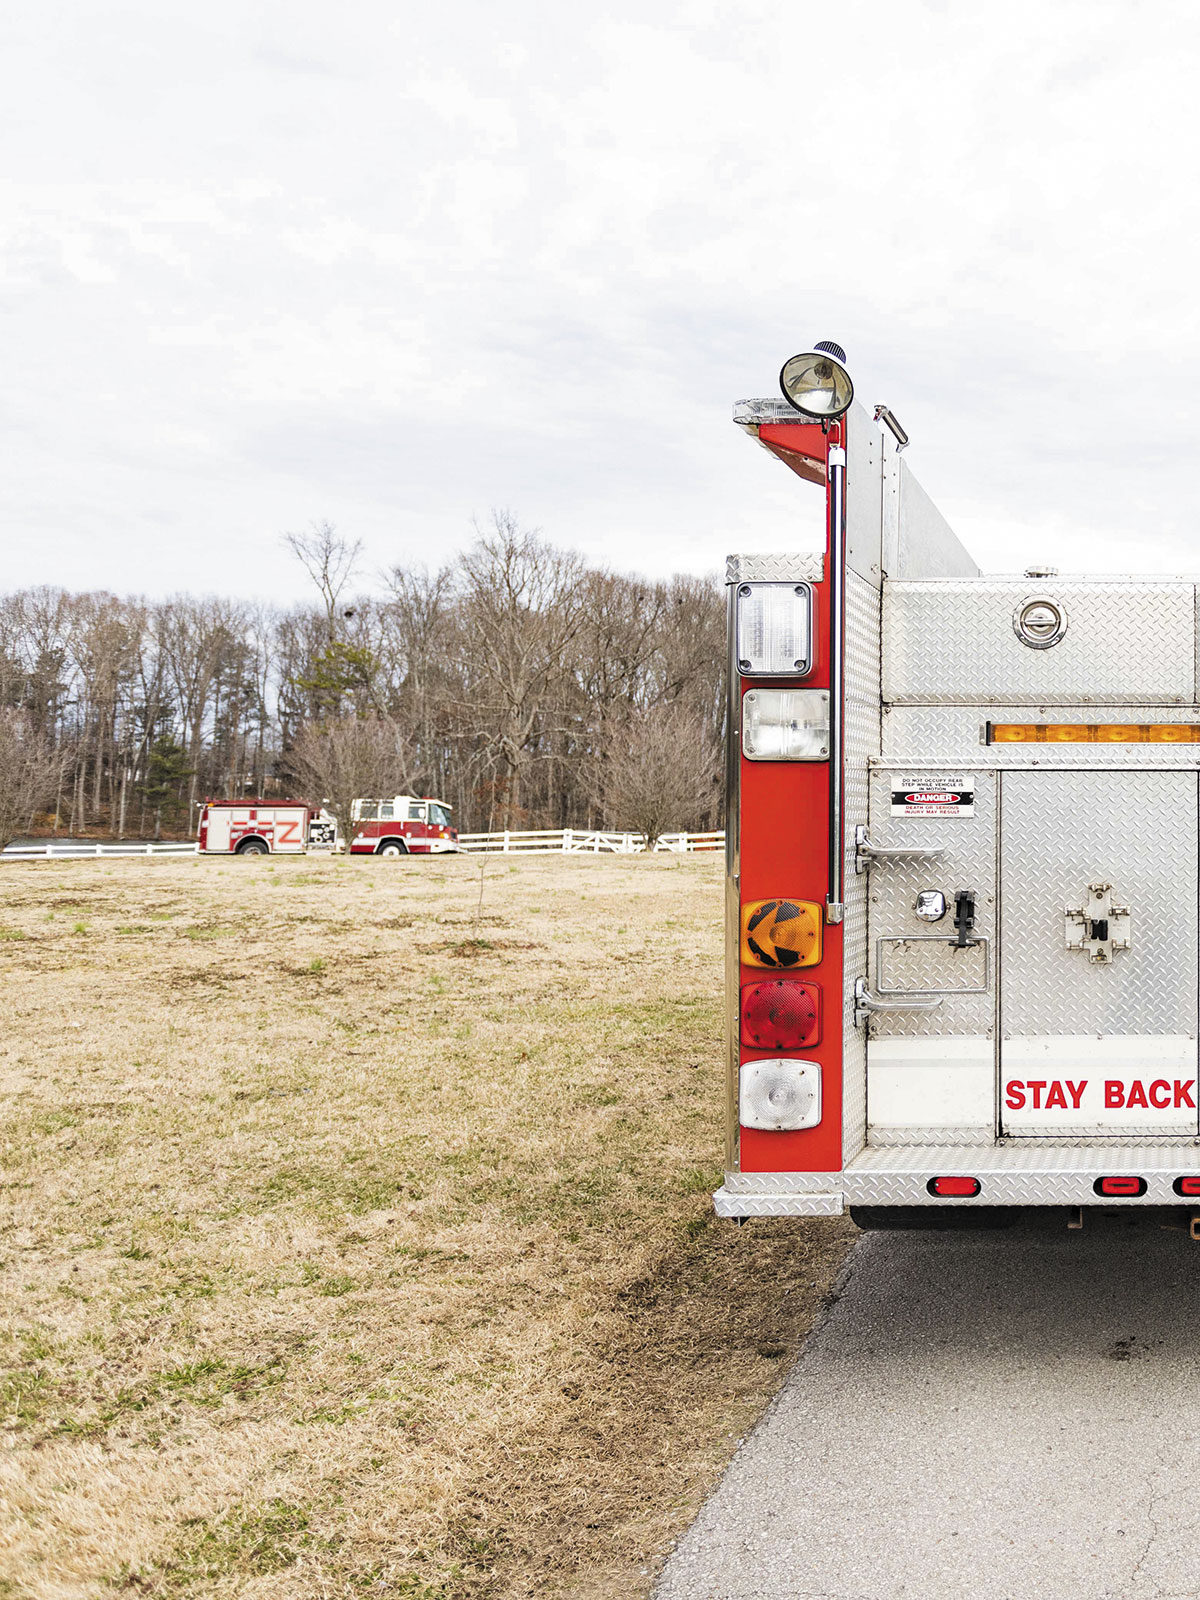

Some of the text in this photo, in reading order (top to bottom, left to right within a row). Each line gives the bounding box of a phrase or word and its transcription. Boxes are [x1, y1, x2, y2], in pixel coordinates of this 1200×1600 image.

[914, 794, 952, 802] DANGER
[1005, 1080, 1088, 1110] STAY
[1104, 1080, 1196, 1109] BACK
